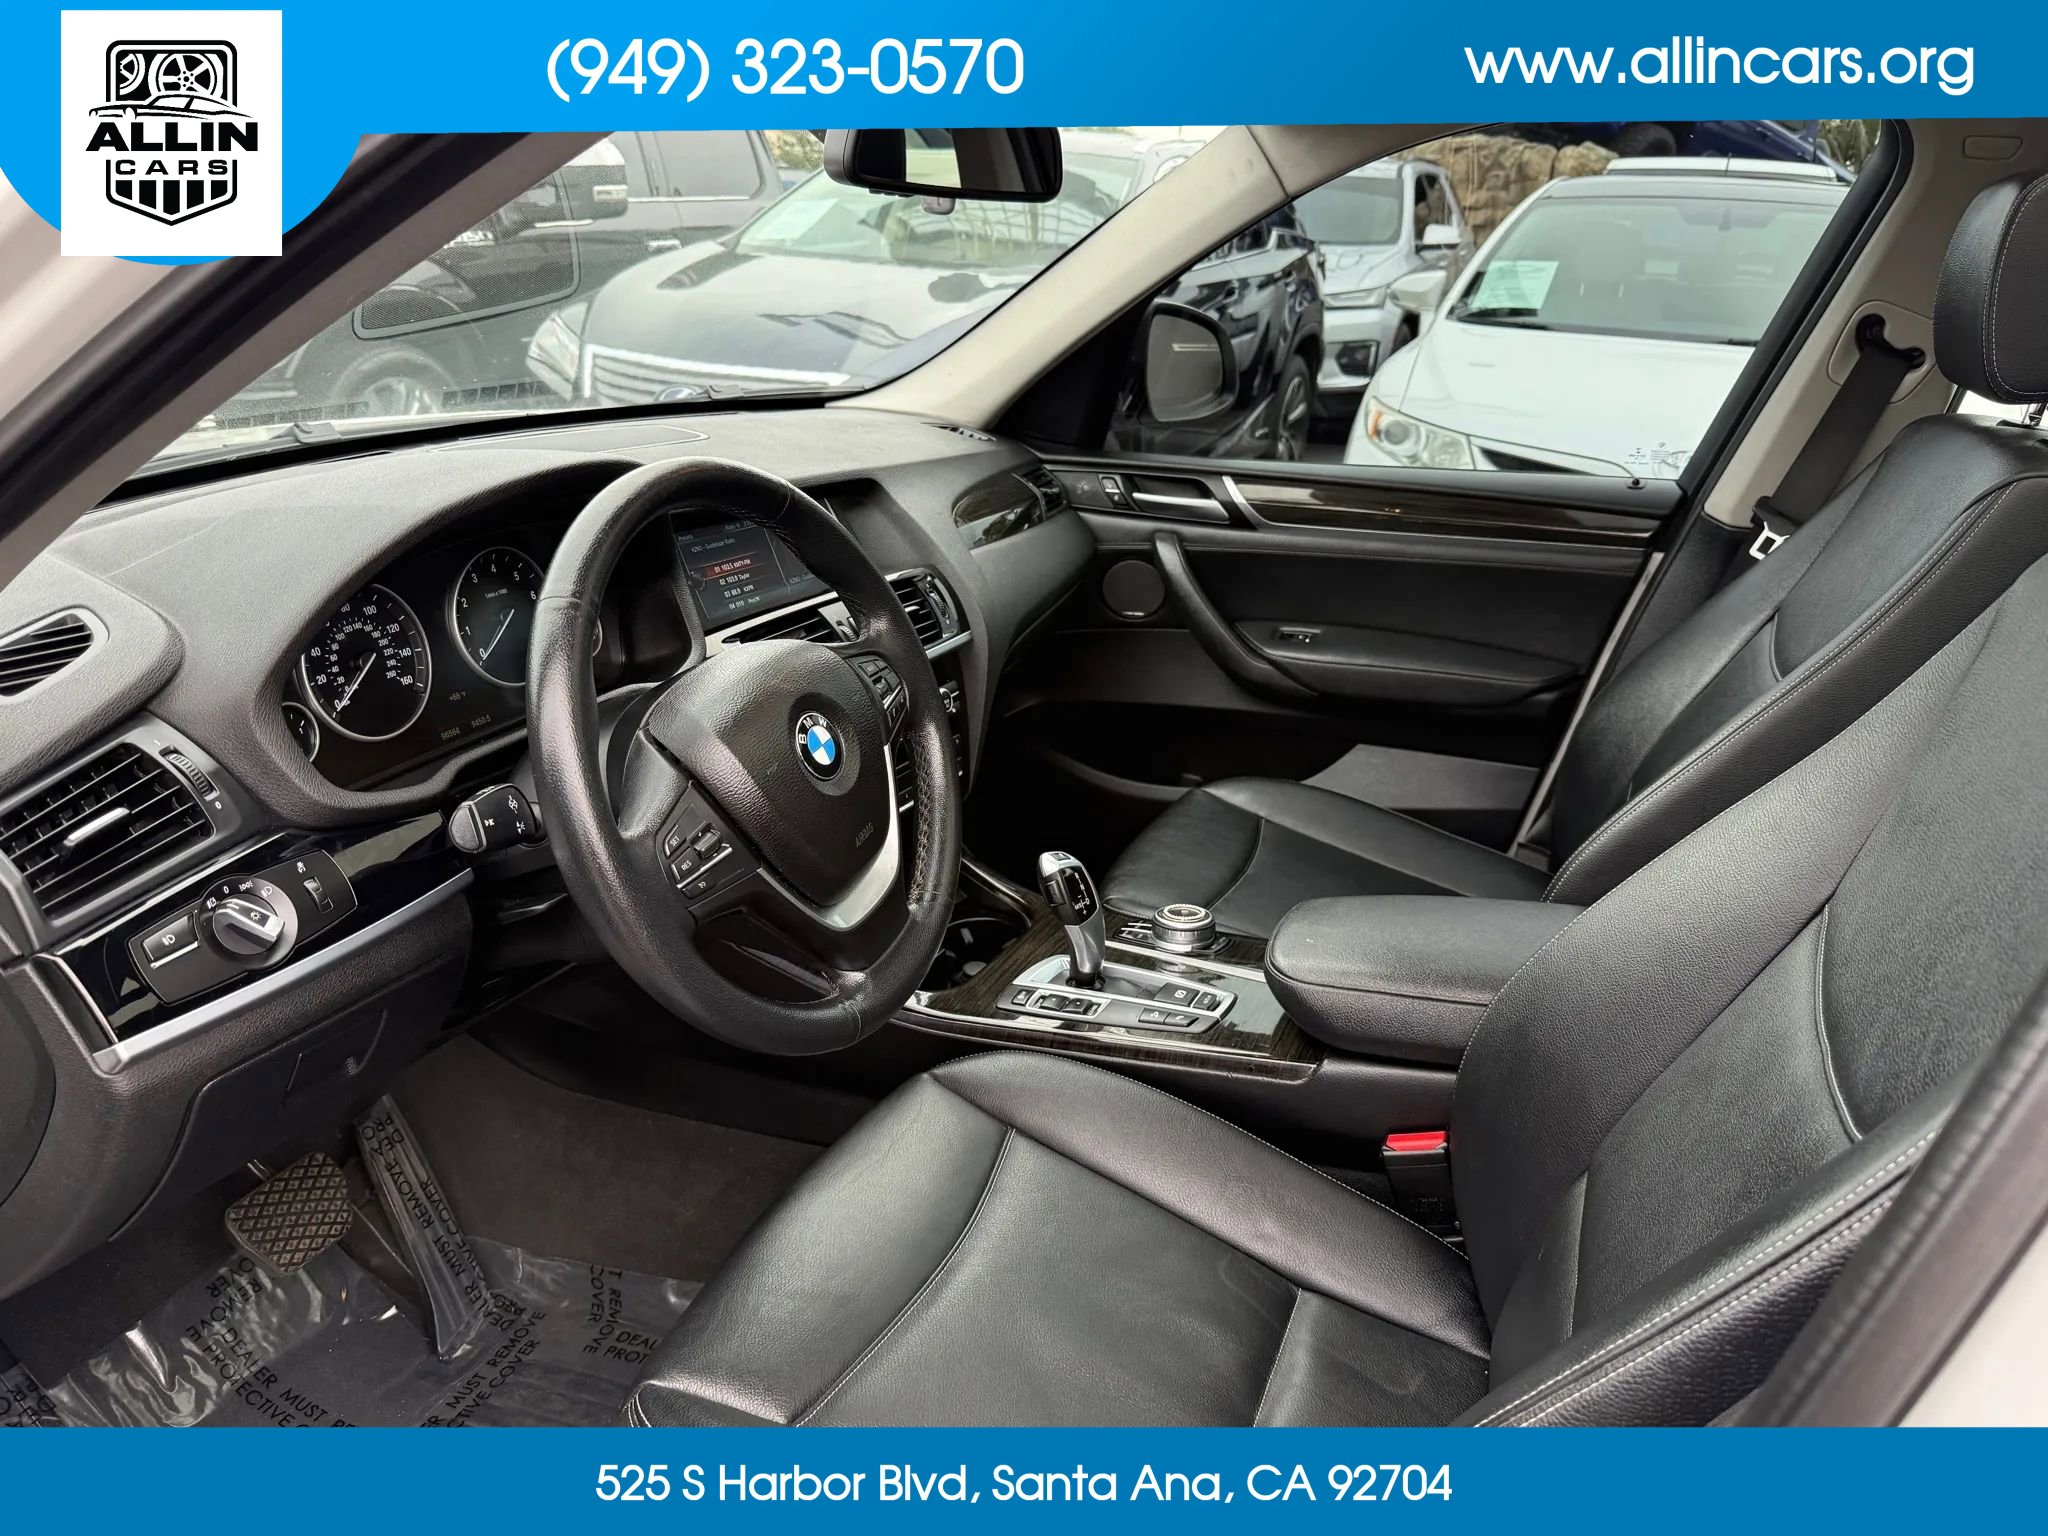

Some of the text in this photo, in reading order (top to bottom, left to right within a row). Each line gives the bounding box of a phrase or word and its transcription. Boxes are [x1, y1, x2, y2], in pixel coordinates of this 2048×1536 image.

[492, 564, 496, 572] 4
[472, 574, 478, 583] 3
[514, 572, 520, 580] 5
[530, 591, 536, 600] 6
[462, 598, 468, 608] 2
[363, 605, 376, 616] 100
[343, 625, 353, 633] 120
[352, 622, 362, 630] 140
[386, 623, 400, 634] 120
[466, 626, 470, 636] 1
[310, 647, 320, 657] 40
[399, 648, 412, 658] 140
[316, 674, 326, 684] 20
[400, 675, 413, 686] 160
[799, 716, 826, 744] BMW
[670, 836, 680, 846] SET
[681, 860, 692, 871] RES
[582, 1288, 622, 1354] REMOVE
[446, 1372, 487, 1408] MUST
[486, 1311, 548, 1368] REMOVE
[489, 1340, 542, 1388] COVER
[222, 1328, 278, 1389] DEALER
[280, 1388, 328, 1422] MUST
